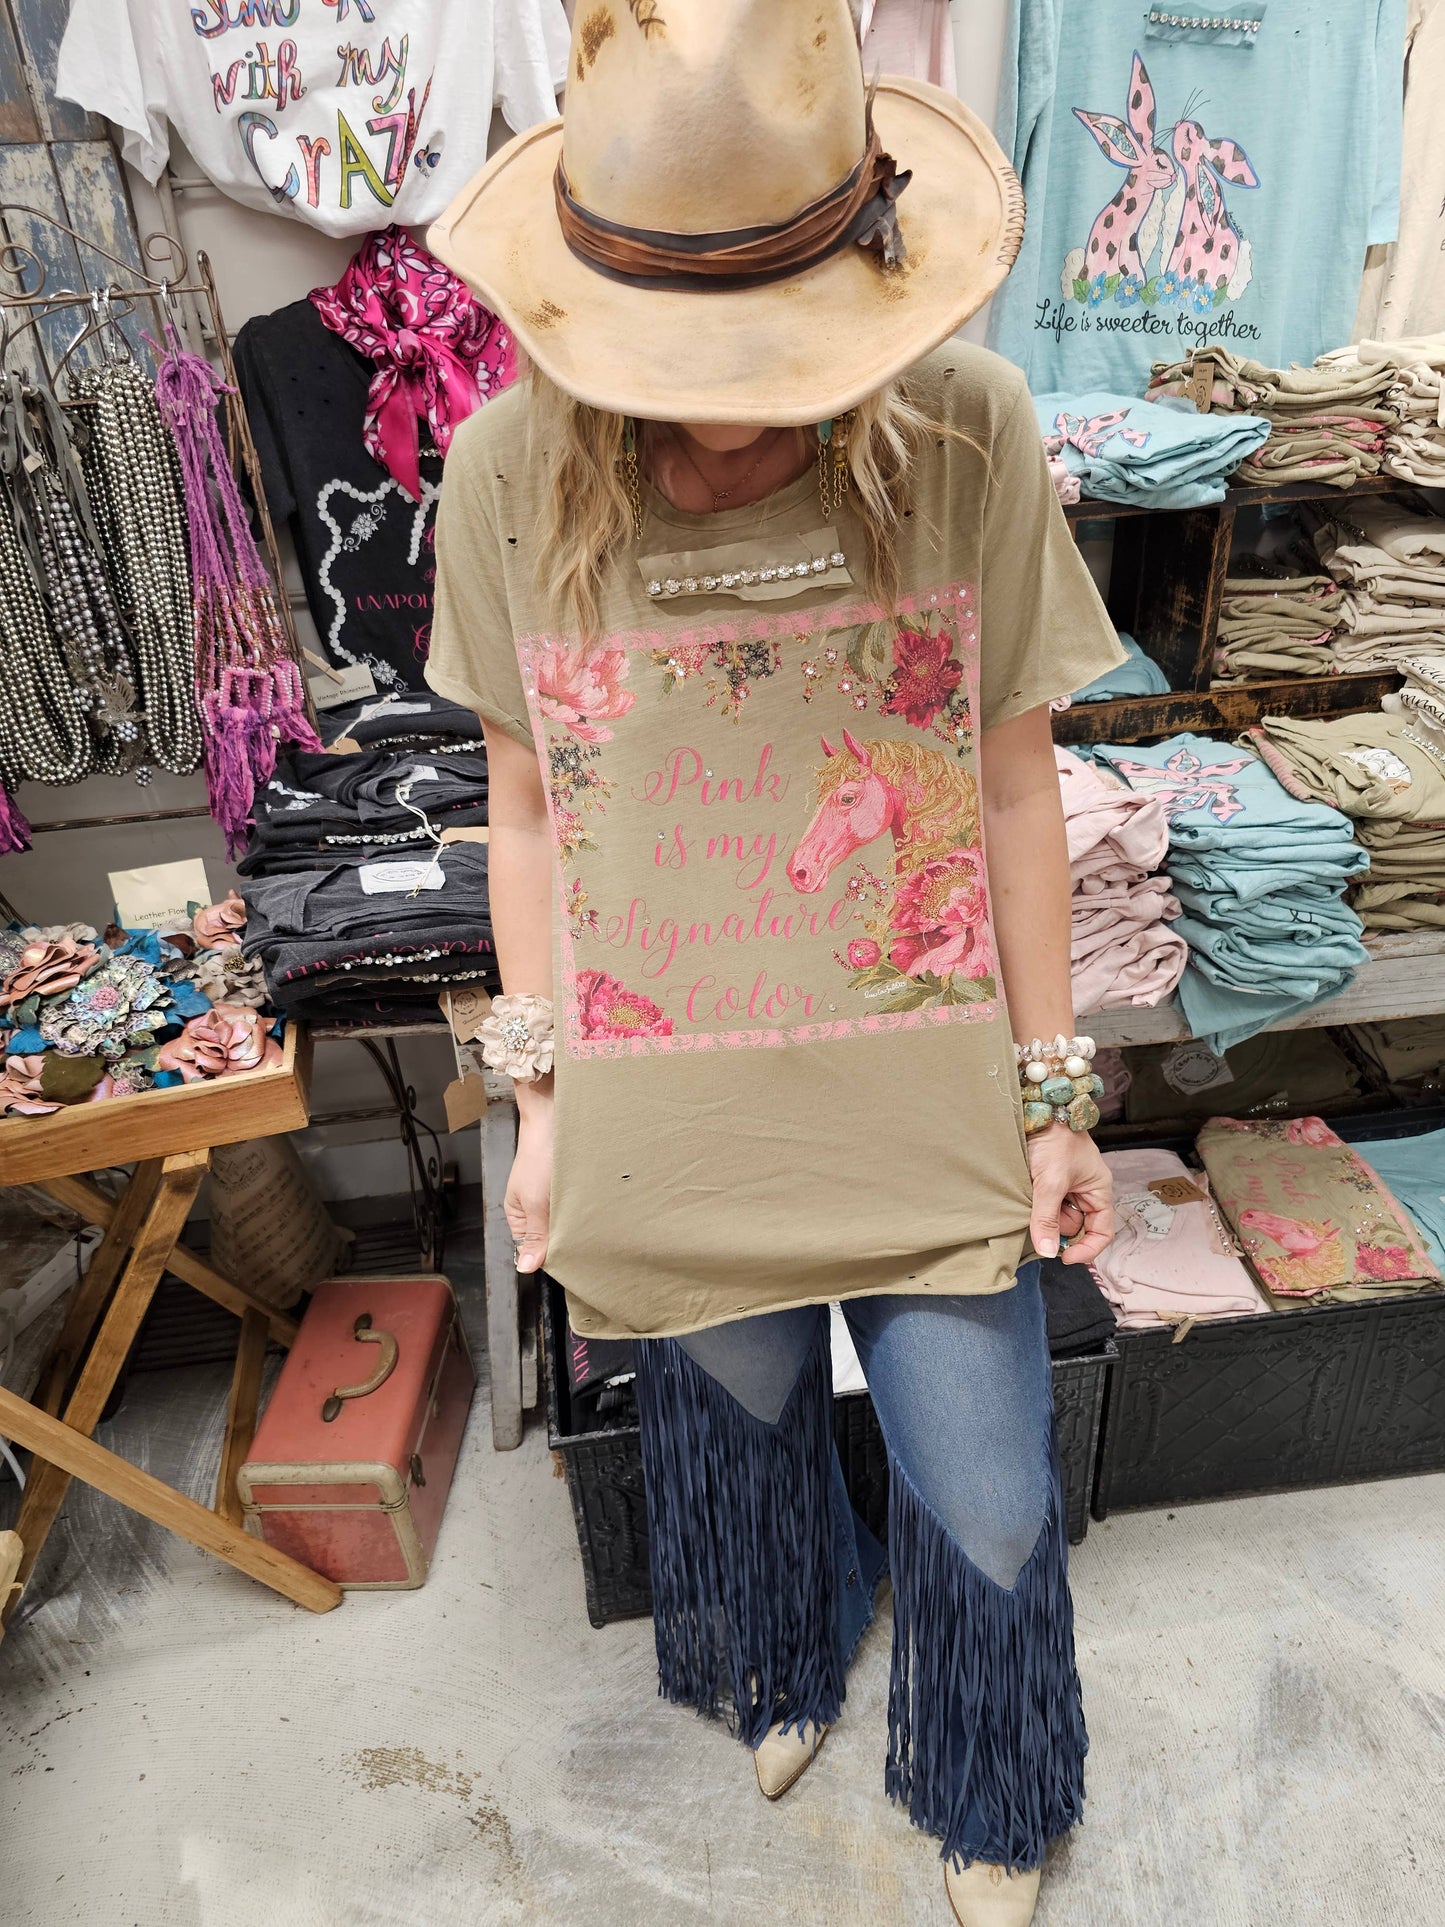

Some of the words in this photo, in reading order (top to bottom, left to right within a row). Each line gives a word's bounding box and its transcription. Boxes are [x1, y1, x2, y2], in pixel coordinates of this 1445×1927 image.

[210, 38, 307, 114] with
[335, 33, 409, 114] my
[1034, 298, 1077, 344] Life
[1081, 310, 1092, 332] is
[1096, 310, 1173, 335] sweeter
[1177, 309, 1262, 348] together
[356, 592, 435, 612] UNAPOL
[631, 743, 792, 806] Pink
[654, 823, 696, 869] is
[705, 830, 793, 890] my
[134, 911, 165, 922] Leather
[167, 908, 186, 917] Flow
[593, 887, 862, 978] Signature
[666, 970, 828, 1023] Color
